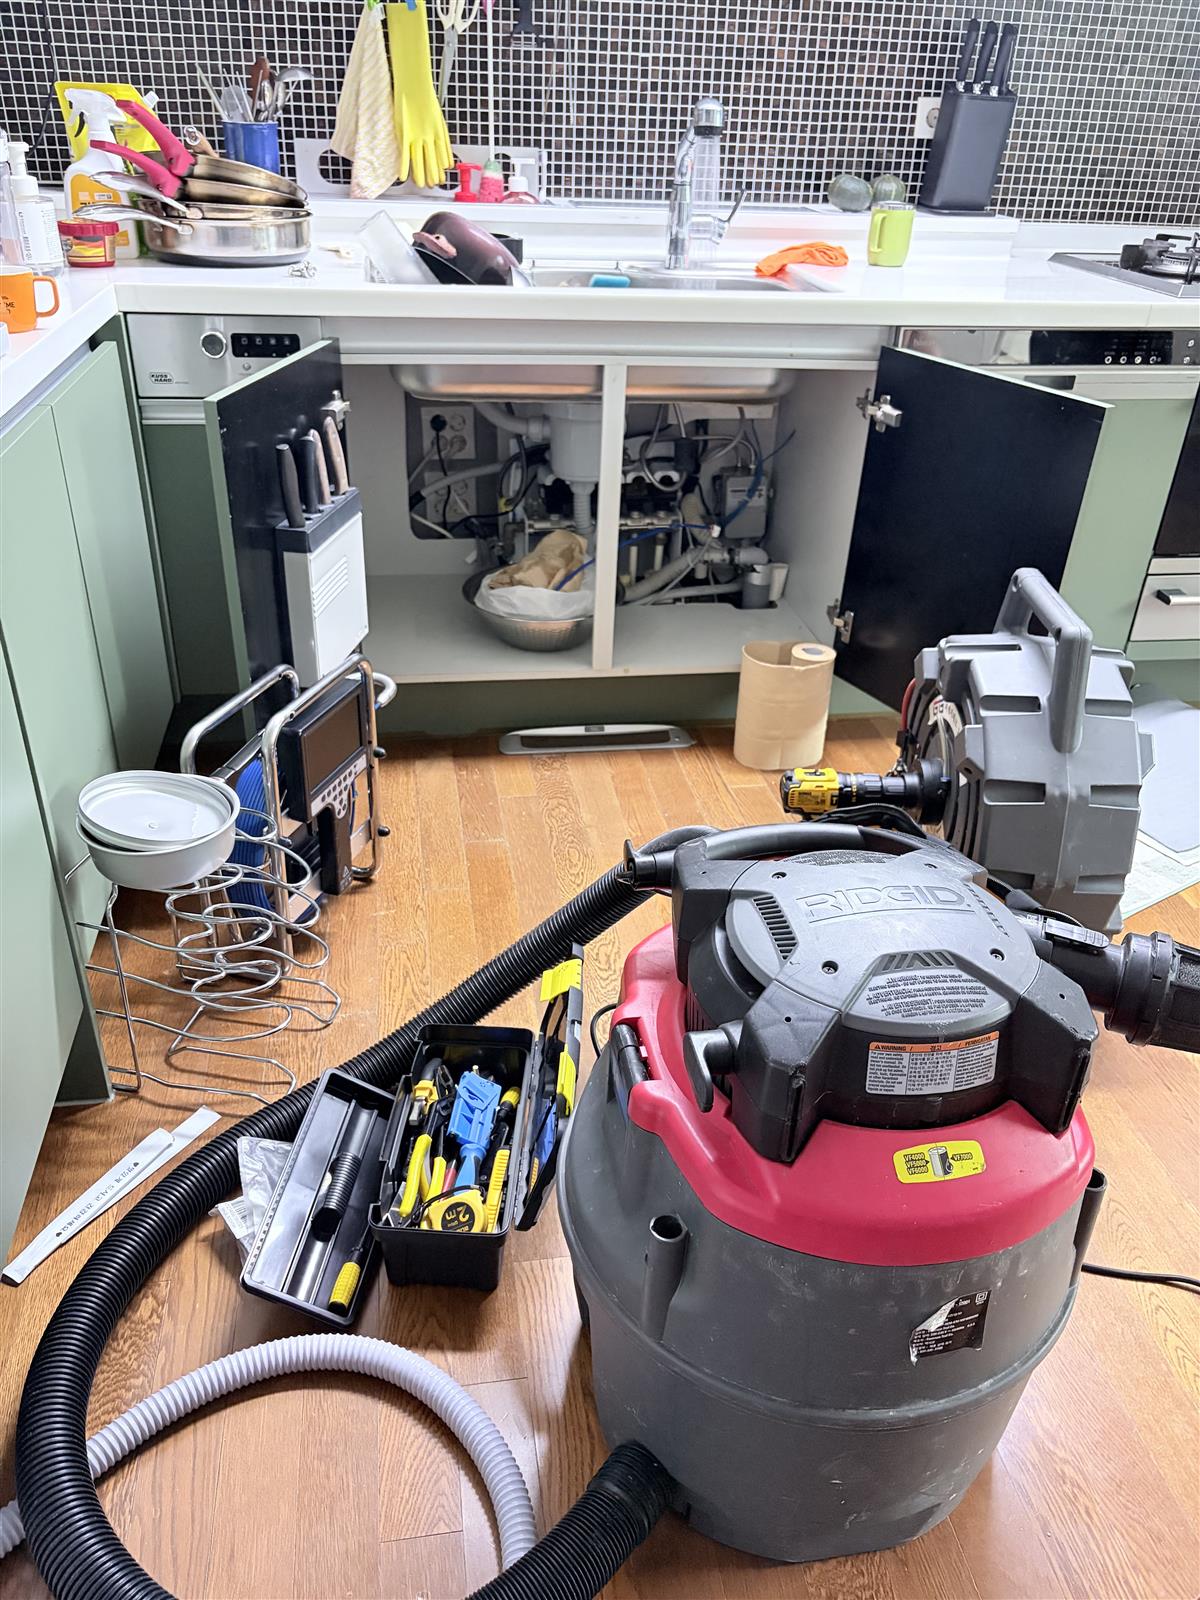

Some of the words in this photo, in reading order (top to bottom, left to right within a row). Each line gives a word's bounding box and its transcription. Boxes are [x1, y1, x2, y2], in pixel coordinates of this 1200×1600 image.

[796, 885, 965, 917] RIDGID
[904, 1153, 924, 1161] VF4000
[96, 1184, 114, 1202] 드시고
[62, 1203, 94, 1231] 건강하세요
